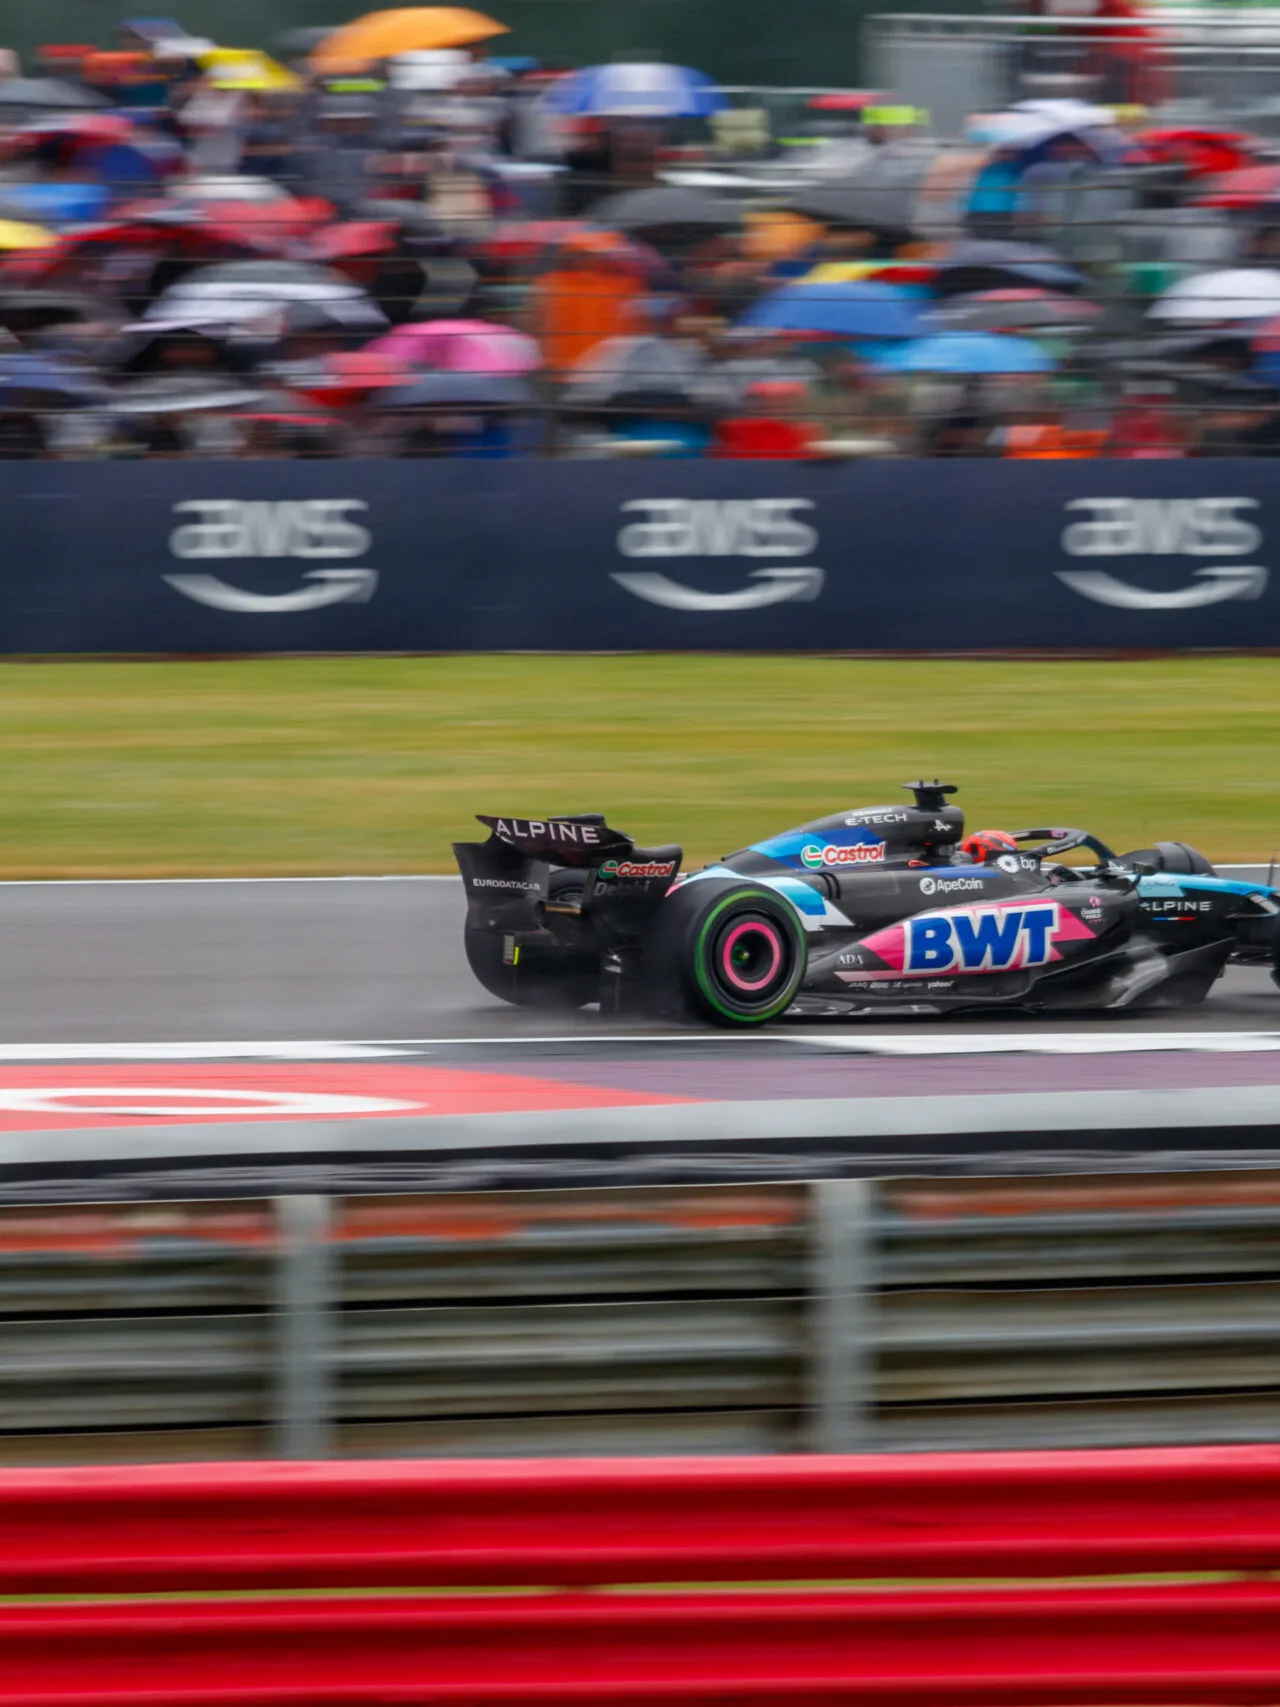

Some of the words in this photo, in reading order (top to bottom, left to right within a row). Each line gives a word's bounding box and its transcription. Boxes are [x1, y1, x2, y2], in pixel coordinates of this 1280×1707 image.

[845, 813, 907, 826] E-TECH
[497, 819, 600, 844] ALPINE
[823, 841, 885, 865] Castrol
[618, 861, 675, 877] Castrol
[1020, 856, 1037, 871] bp
[473, 878, 541, 891] EURODATACAR
[594, 880, 649, 898] Delphi
[937, 878, 983, 891] ApeCoin
[906, 906, 1057, 972] BWT
